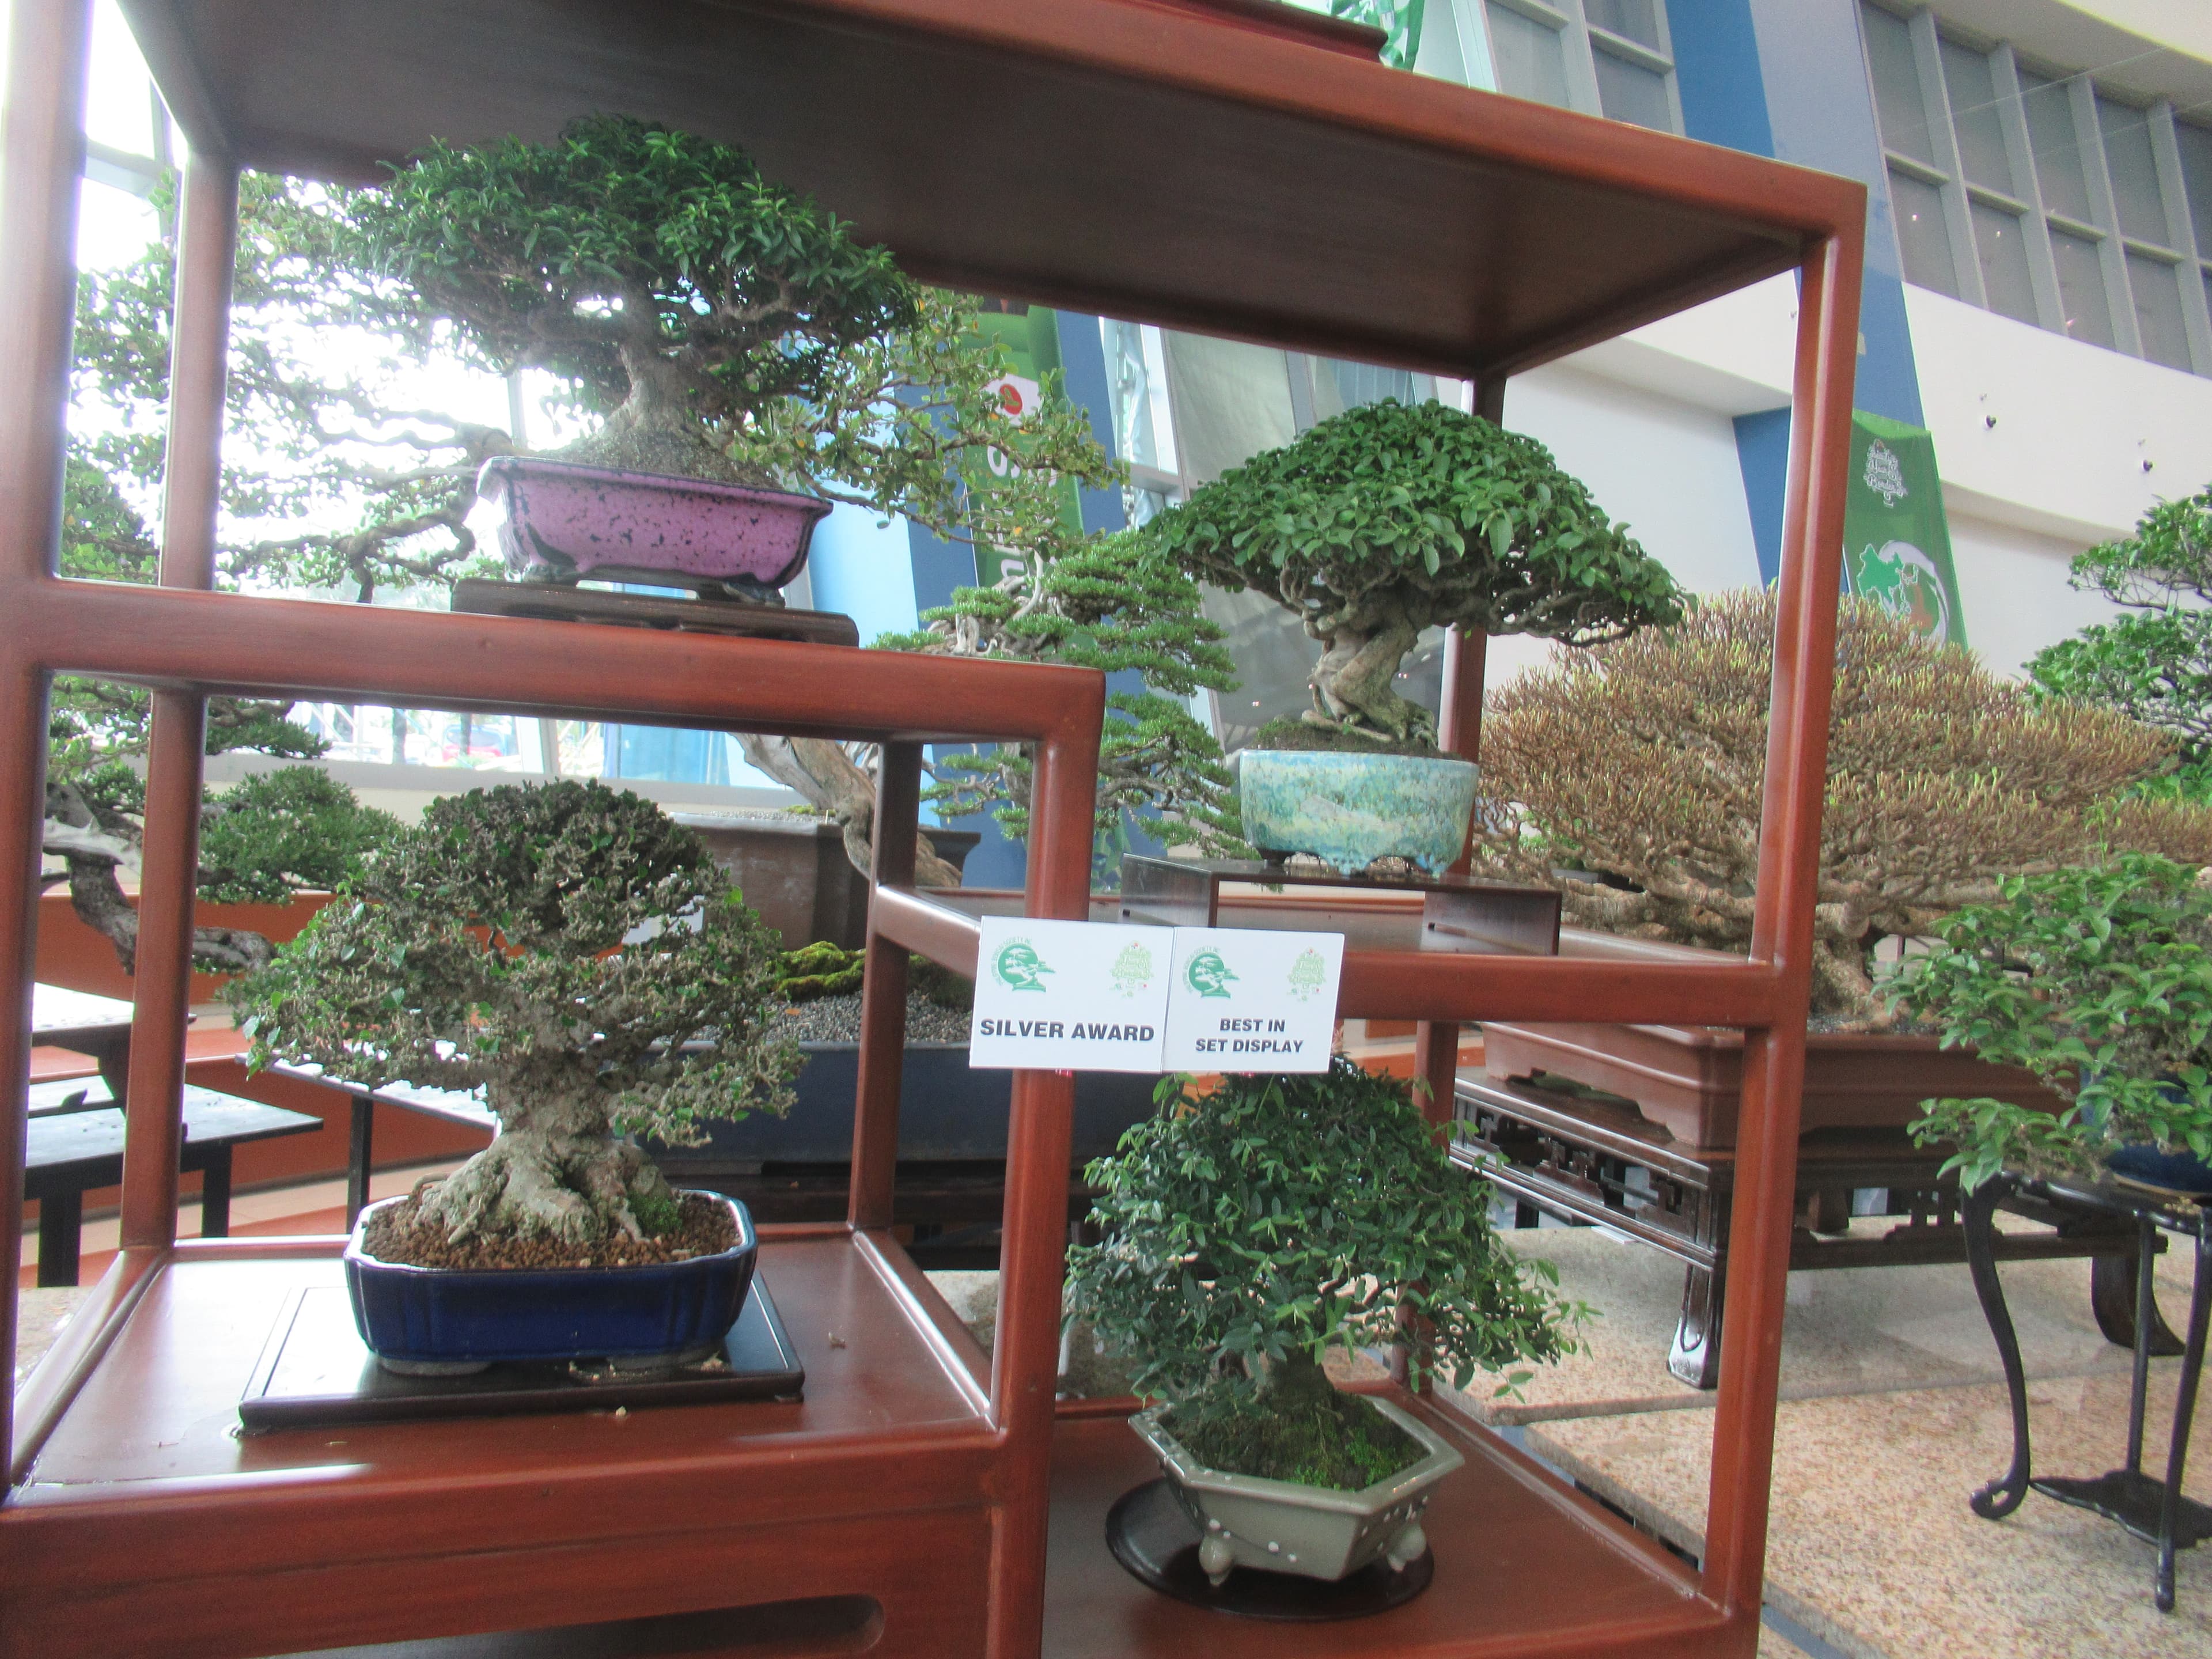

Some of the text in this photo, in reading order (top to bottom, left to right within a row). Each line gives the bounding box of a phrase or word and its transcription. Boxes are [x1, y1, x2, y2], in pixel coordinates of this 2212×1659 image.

[980, 1020, 1155, 1041] SILVER AWARD
[1219, 1018, 1286, 1033] BEST IN
[1196, 1039, 1303, 1054] SET DISPLAY
